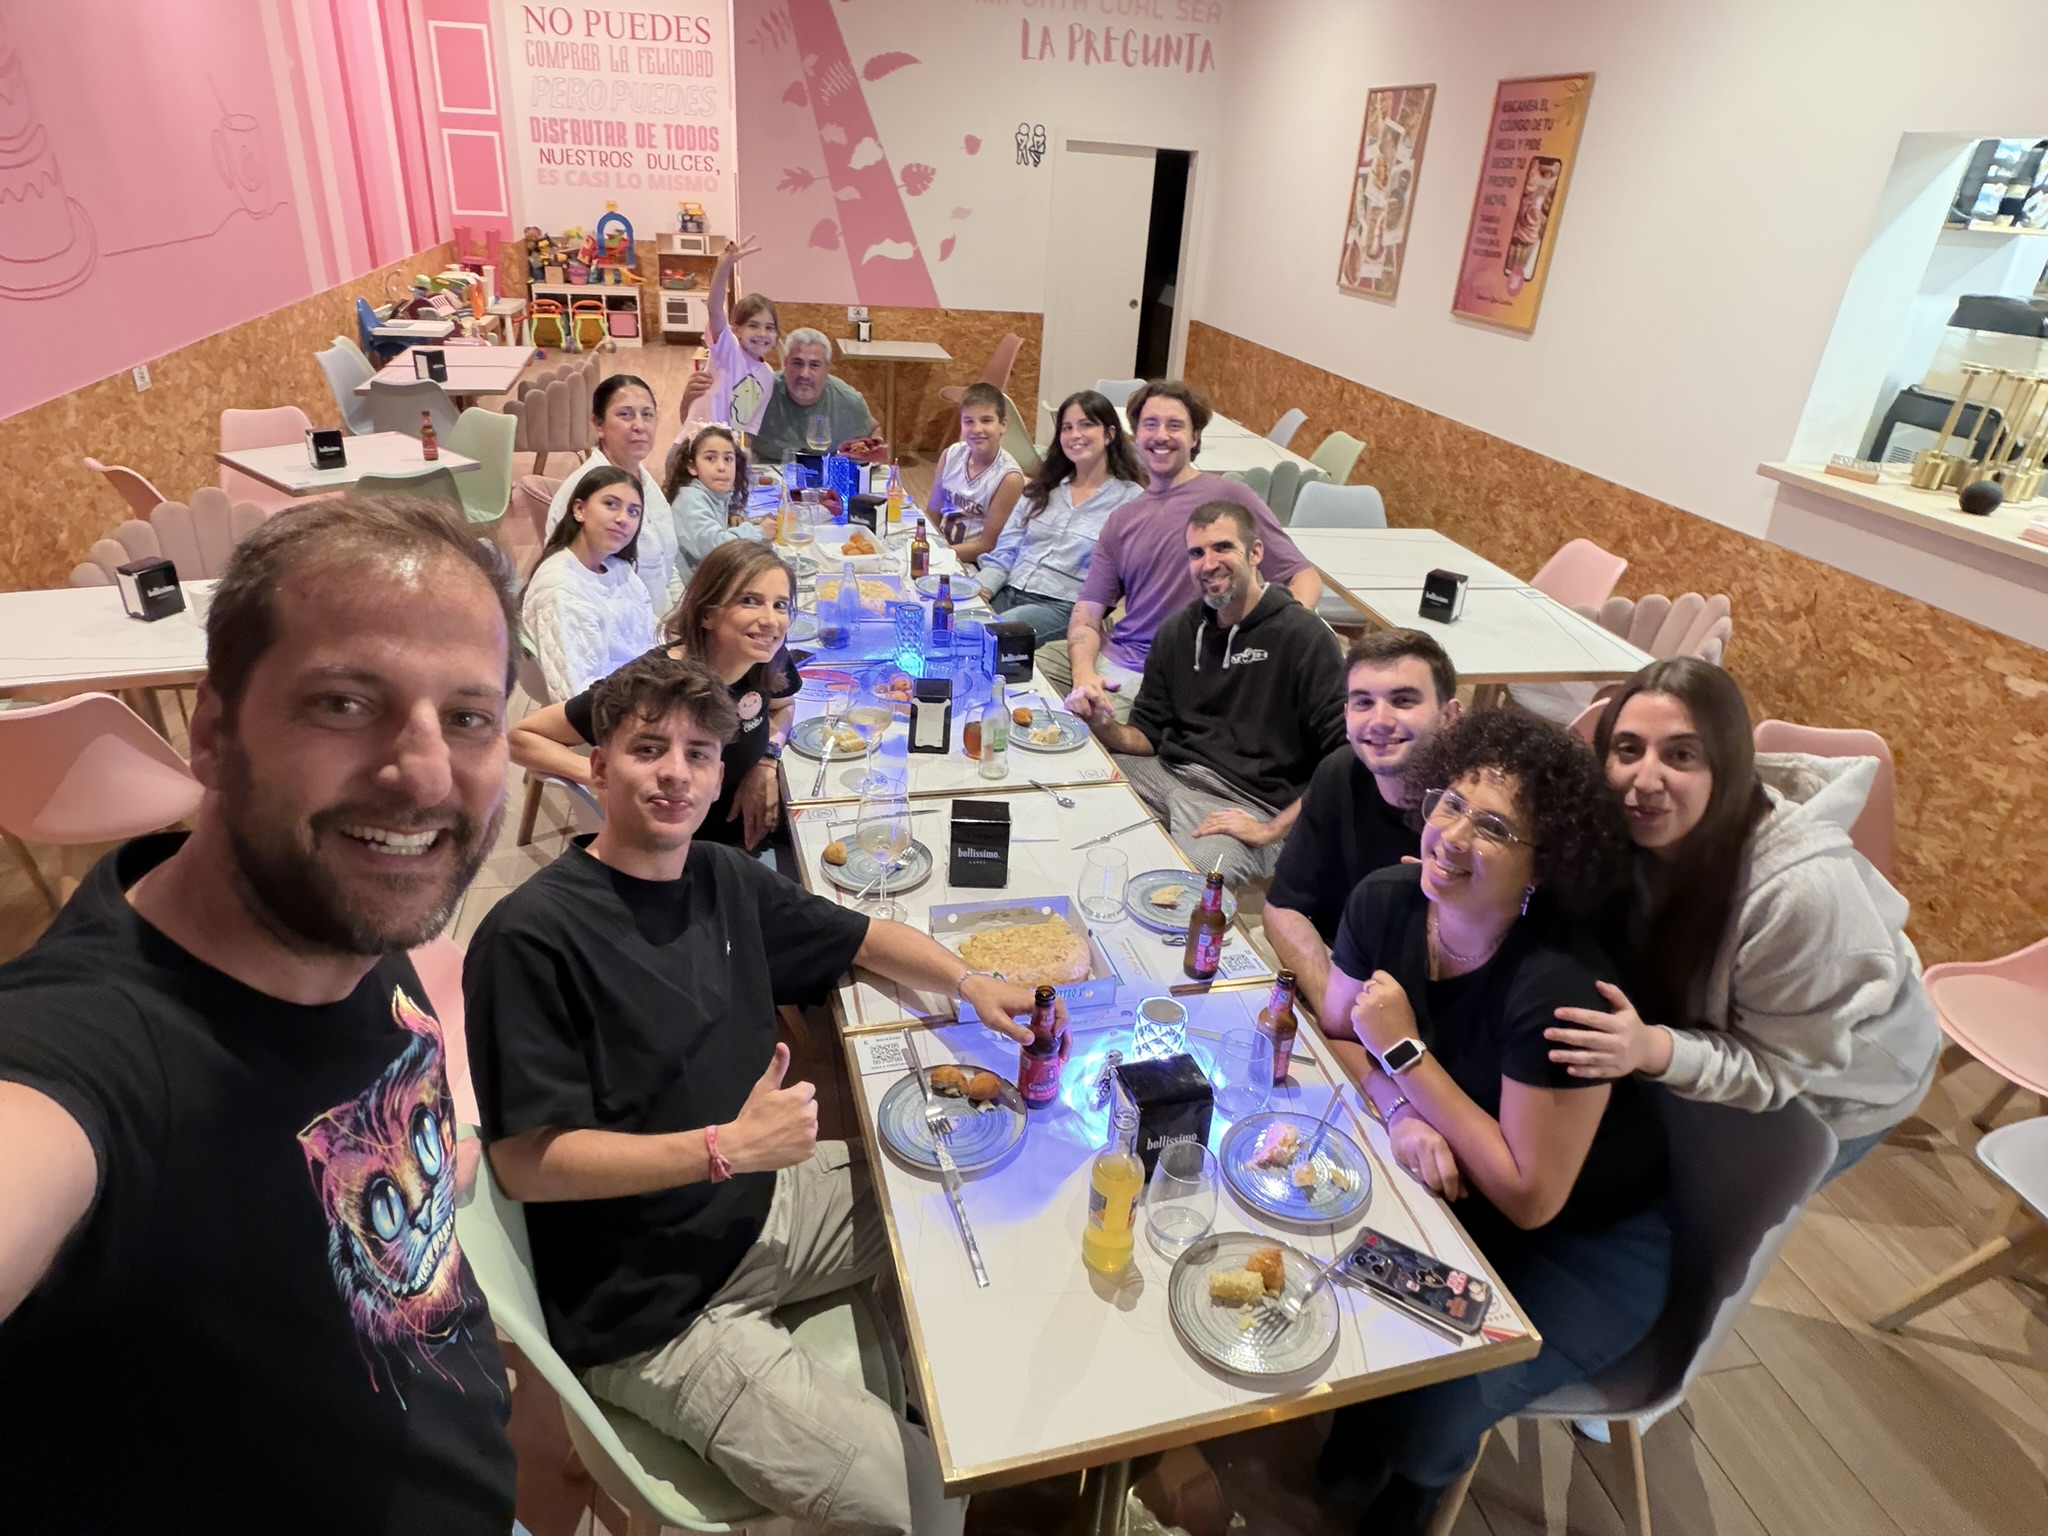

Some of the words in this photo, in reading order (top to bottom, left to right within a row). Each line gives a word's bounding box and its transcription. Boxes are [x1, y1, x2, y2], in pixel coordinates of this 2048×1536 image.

[520, 5, 573, 36] NO
[582, 8, 711, 45] PUEDES
[1176, 0, 1223, 24] SEA
[525, 39, 601, 72] COMPRAR
[608, 44, 630, 73] LA
[637, 46, 714, 78] FELICIDAD
[1021, 18, 1055, 61] LA
[1067, 22, 1216, 74] PREGUNTA
[530, 75, 608, 112] PERO
[610, 79, 718, 118] PUEDES
[635, 122, 658, 149] DE
[663, 123, 720, 153] TODOS
[539, 147, 634, 169] NUESTROS
[646, 152, 721, 176] DULCES,
[537, 168, 561, 186] ES
[564, 169, 611, 189] CASI
[615, 172, 642, 190] LO
[647, 173, 719, 193] MISMO
